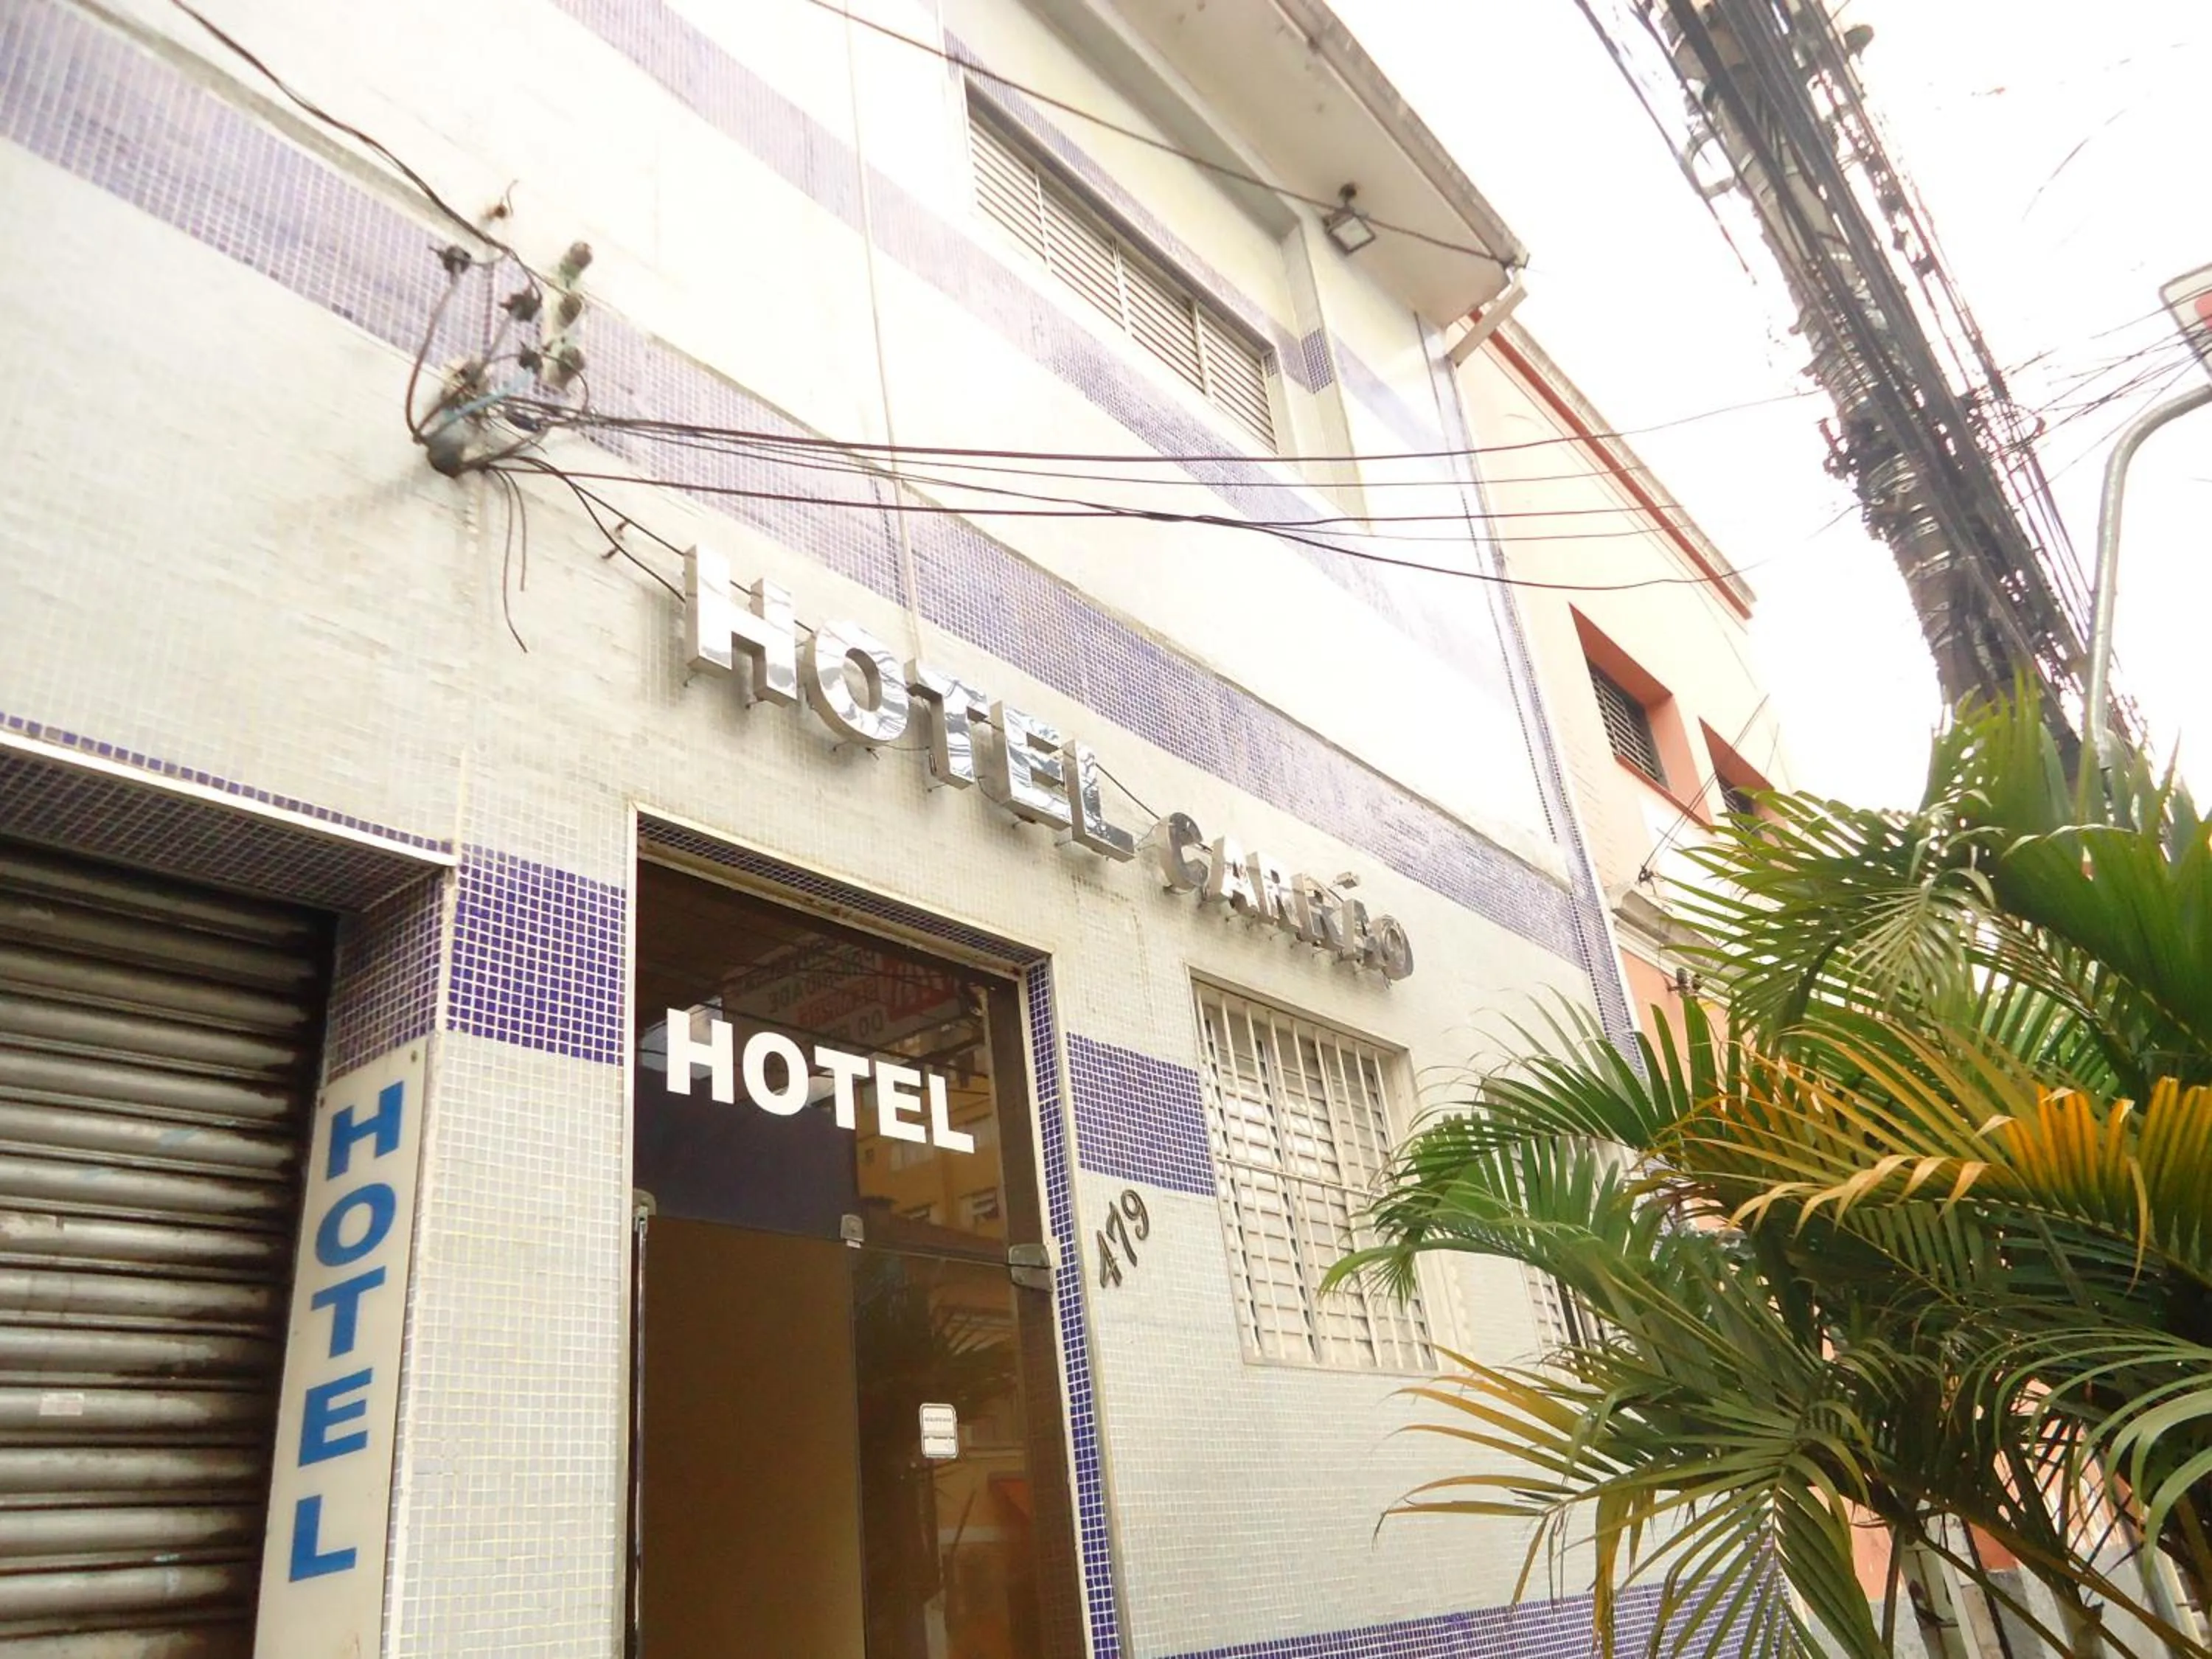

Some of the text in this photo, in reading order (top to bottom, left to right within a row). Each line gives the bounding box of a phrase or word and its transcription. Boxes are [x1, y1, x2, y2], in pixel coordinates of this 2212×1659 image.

[684, 543, 1135, 863] HOTEL
[667, 1007, 975, 1154] HOTEL
[288, 1080, 404, 1583] HOTEL
[1097, 1189, 1150, 1289] 479
